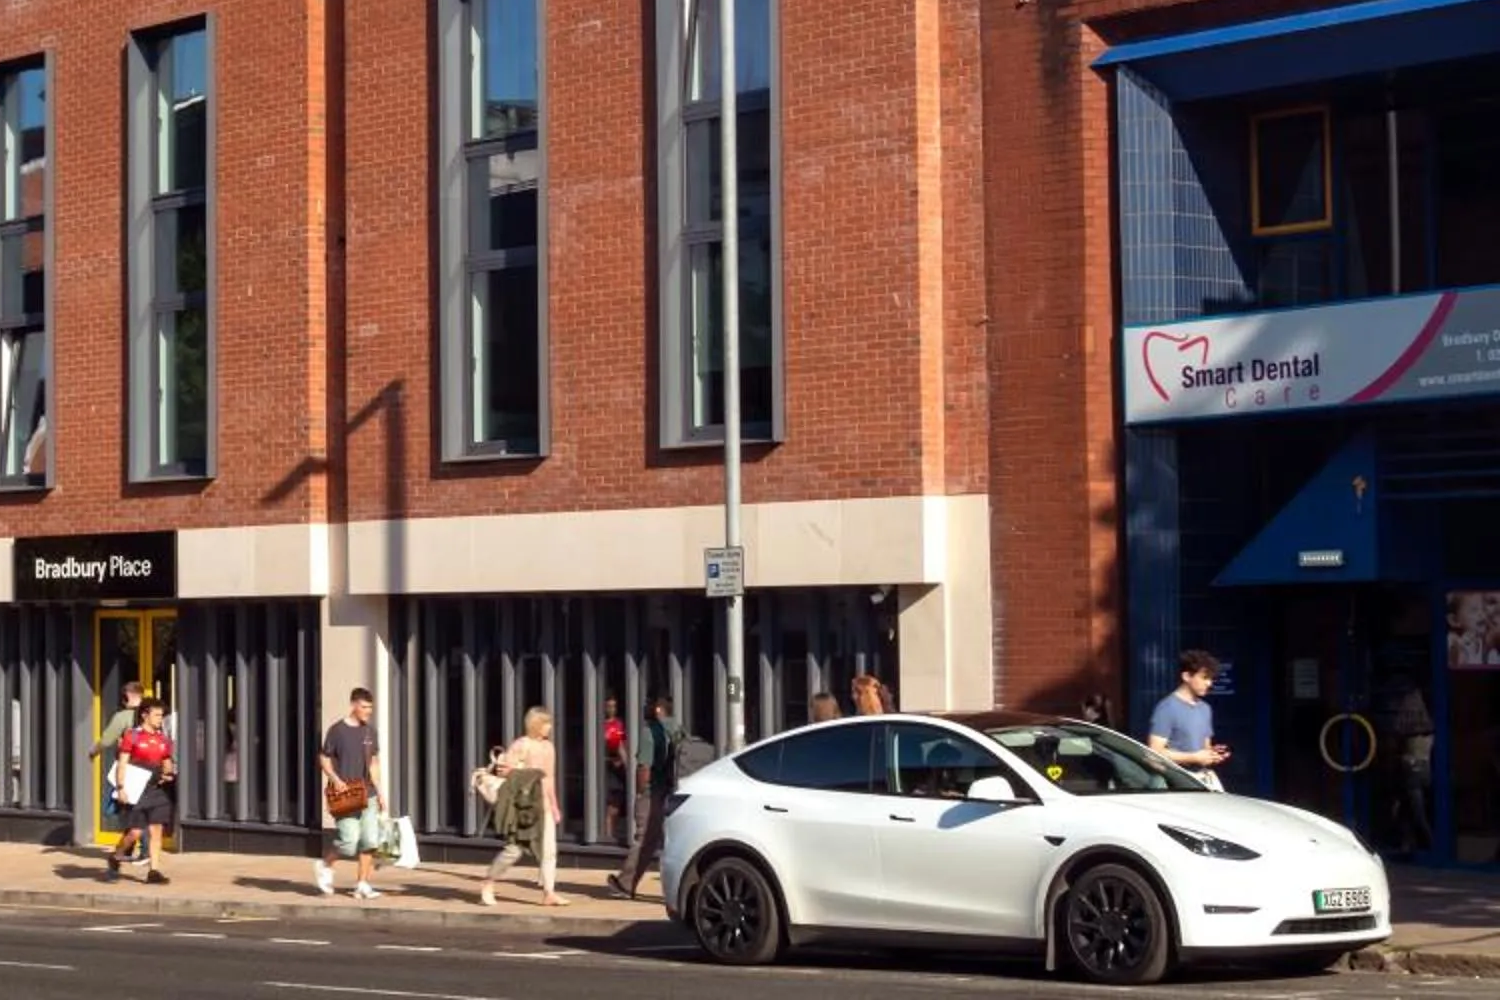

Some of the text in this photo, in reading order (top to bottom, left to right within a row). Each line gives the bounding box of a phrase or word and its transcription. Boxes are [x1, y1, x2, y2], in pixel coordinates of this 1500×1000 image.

[1181, 352, 1319, 388] Smart Dental
[1224, 383, 1320, 409] Care
[35, 555, 151, 582] Bradbury Place
